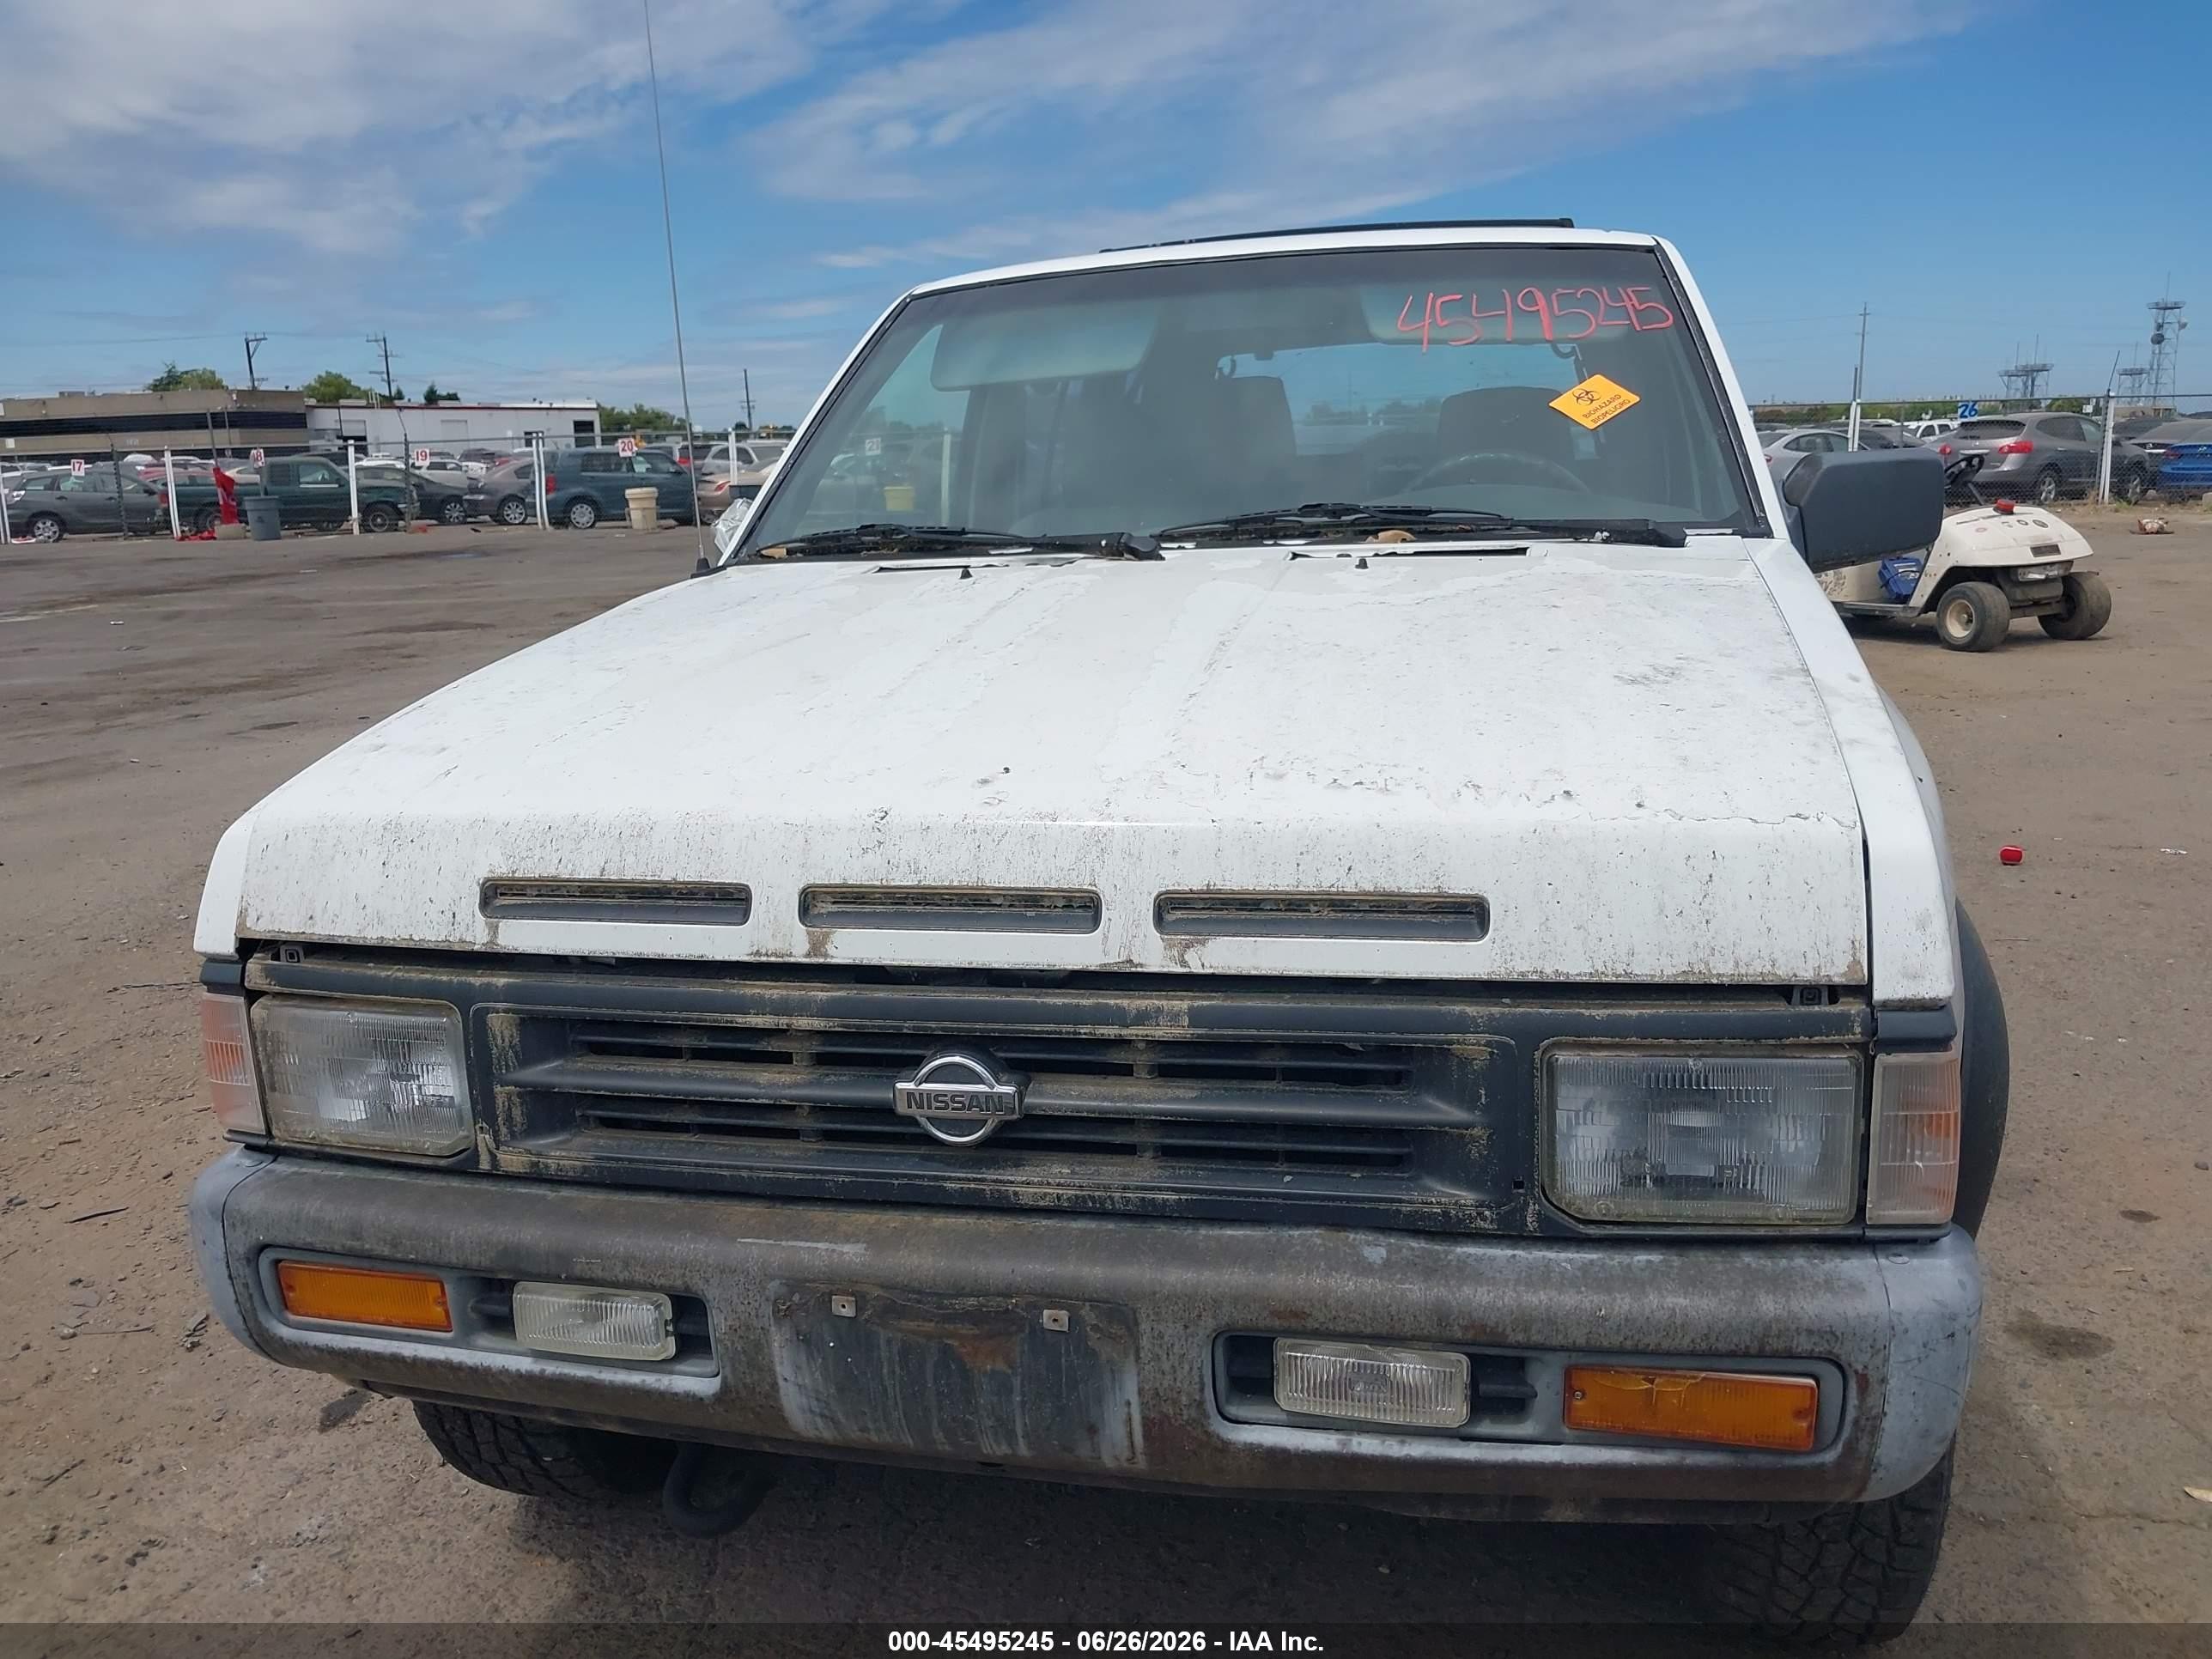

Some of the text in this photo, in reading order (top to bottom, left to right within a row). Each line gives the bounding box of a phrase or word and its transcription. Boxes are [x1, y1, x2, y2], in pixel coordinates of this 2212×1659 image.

[1397, 287, 1674, 352] 45495245
[1583, 394, 1622, 418] BIOHAZARD
[1591, 398, 1632, 424] BIOPELIGRO
[1959, 400, 1978, 419] 26
[416, 449, 428, 462] 19
[620, 440, 634, 453] 20
[72, 461, 83, 471] 17
[906, 1091, 1005, 1115] NISSAN
